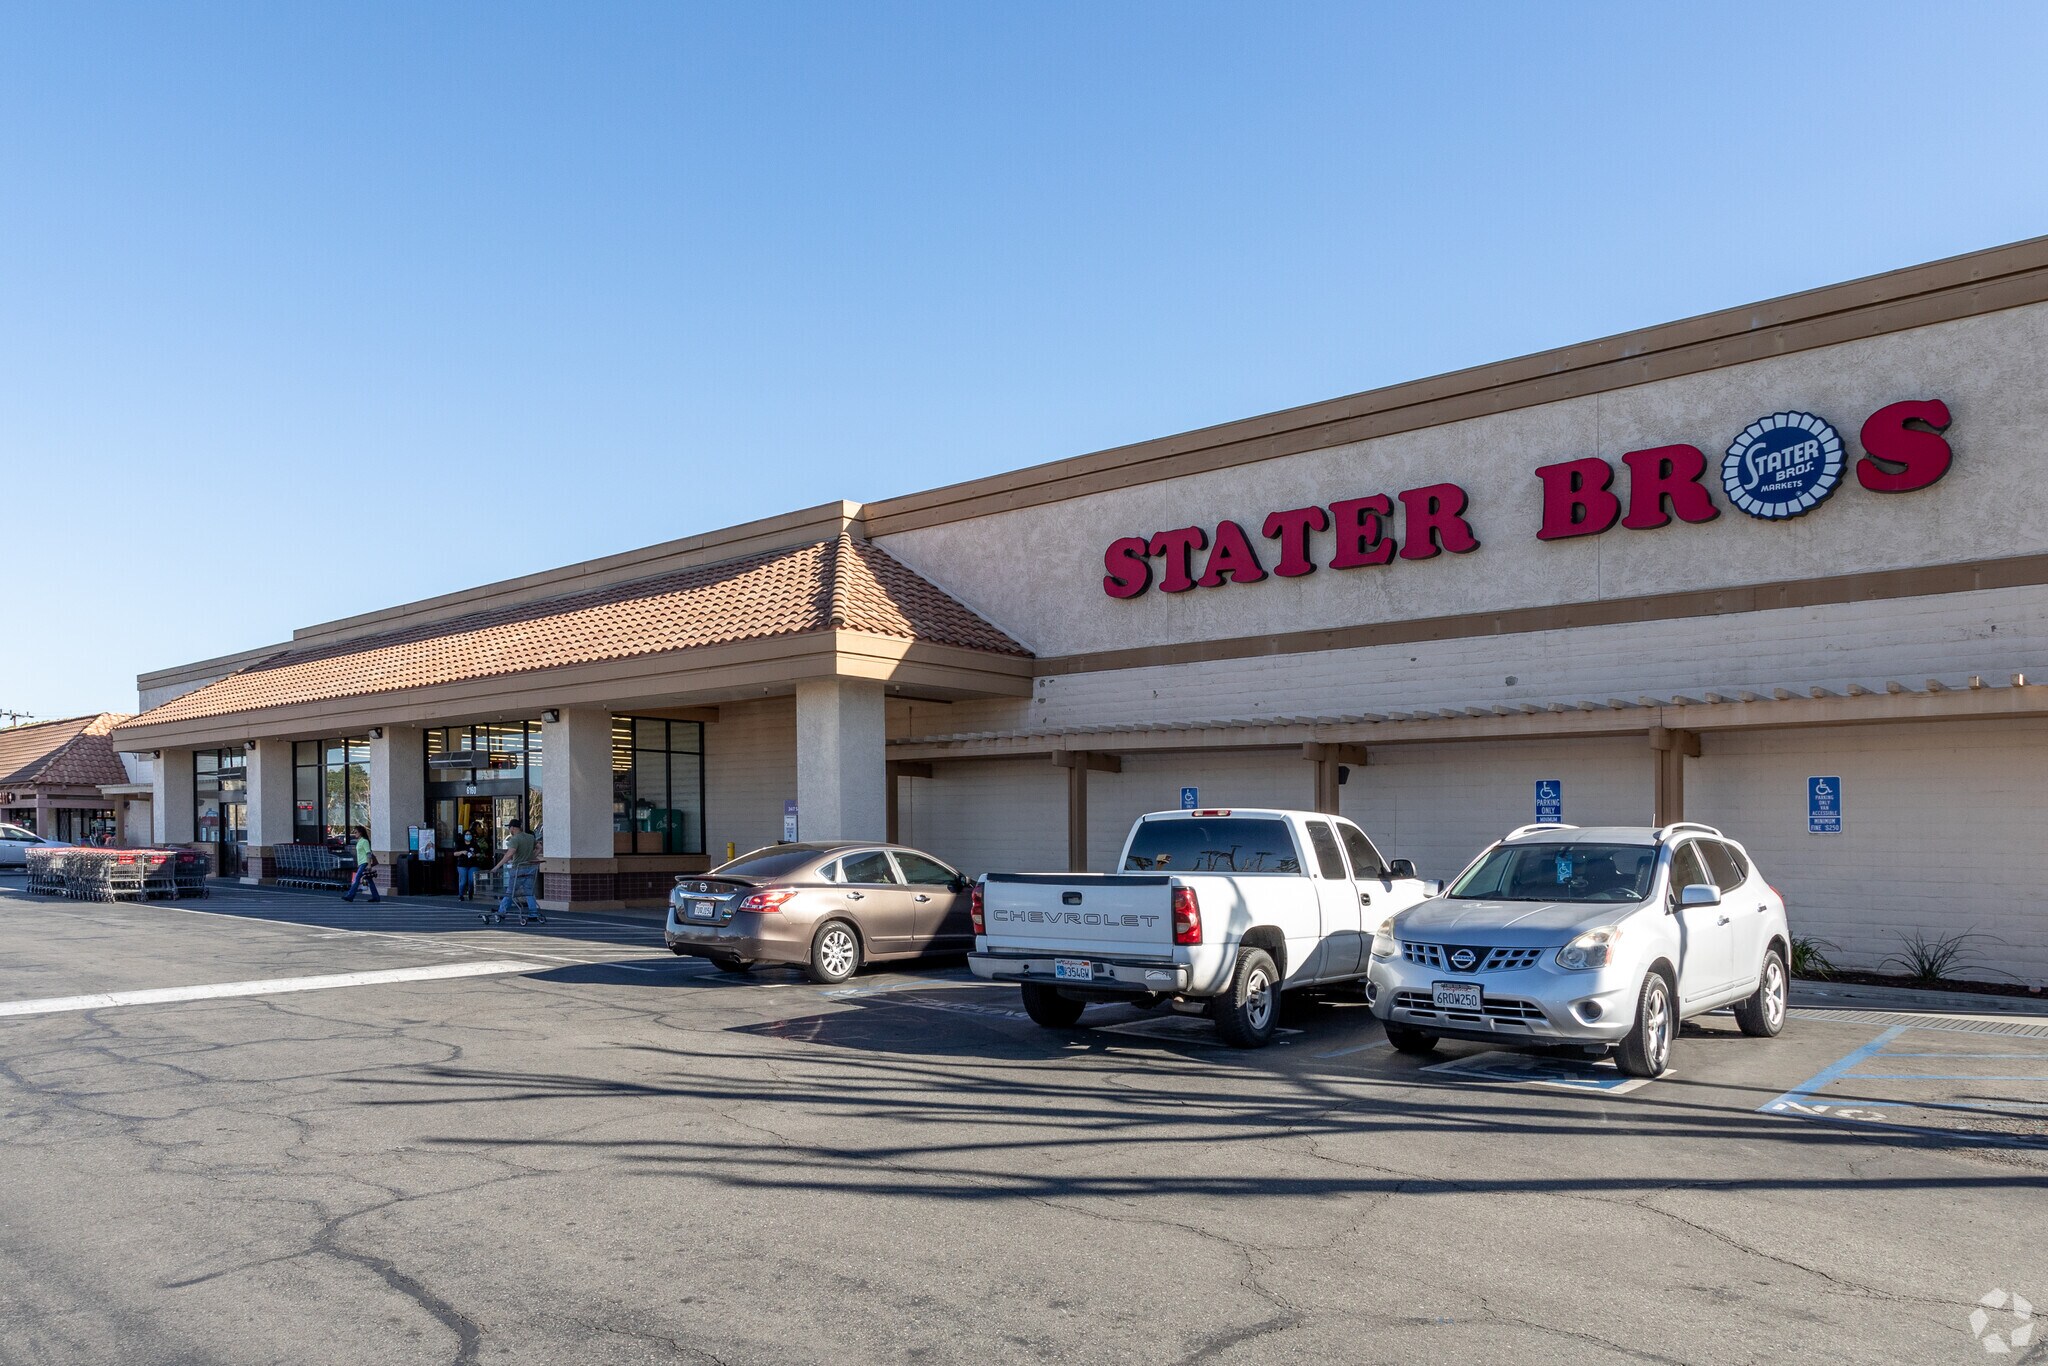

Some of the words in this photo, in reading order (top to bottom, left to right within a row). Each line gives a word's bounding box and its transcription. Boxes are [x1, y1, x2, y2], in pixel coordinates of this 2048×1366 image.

[1744, 439, 1820, 490] STATER
[1776, 461, 1815, 481] BROS.
[1761, 480, 1802, 492] MARKETS
[1103, 483, 1480, 599] STATER
[1537, 799, 1560, 807] PARKING
[993, 909, 1160, 928] CHEVROLET
